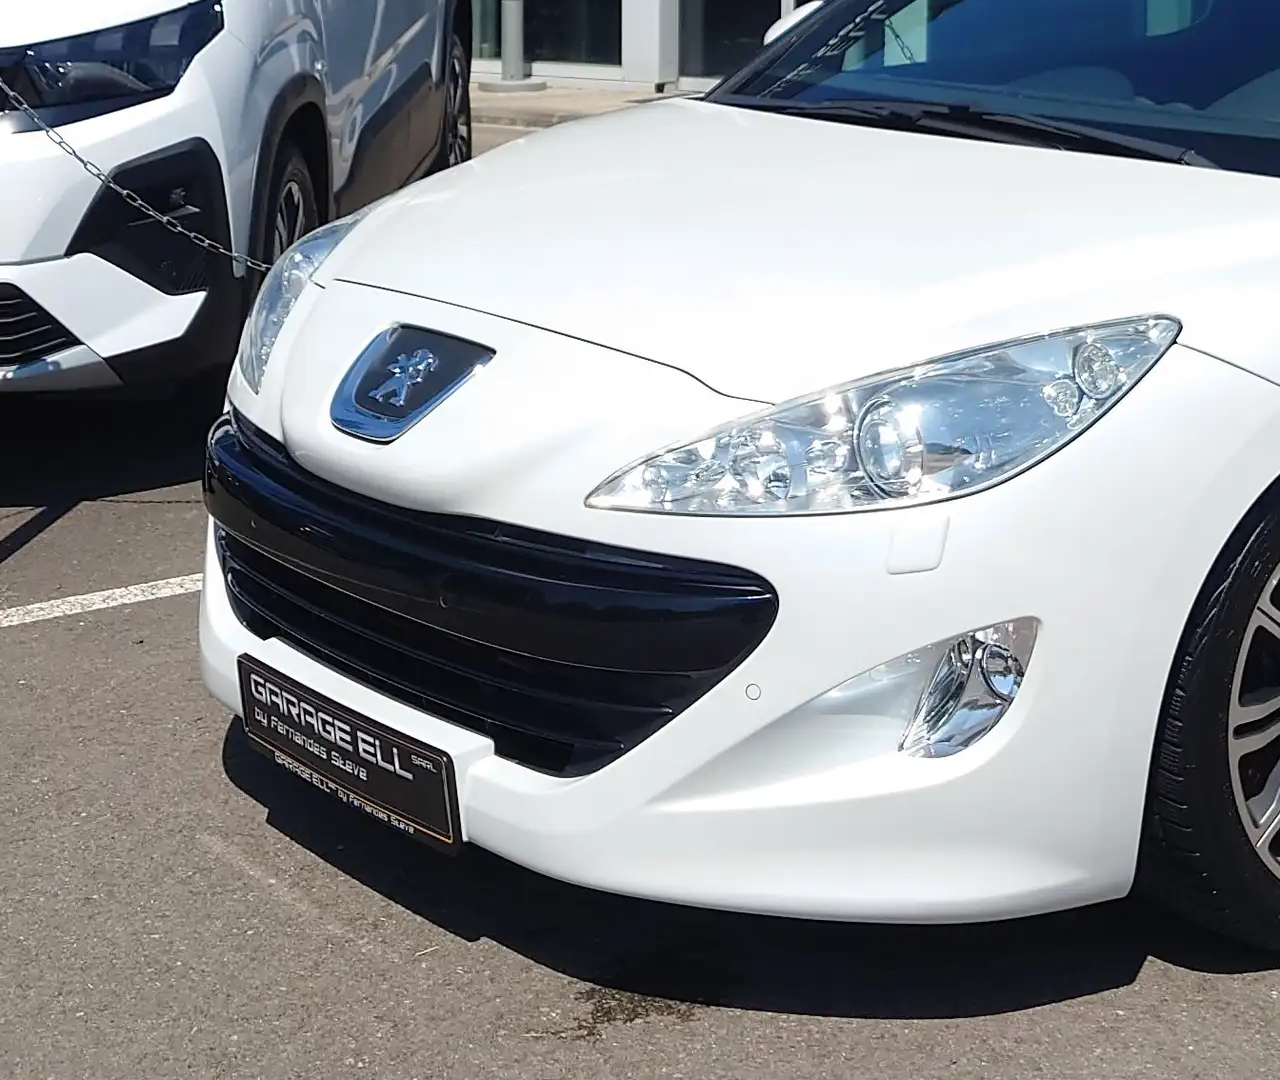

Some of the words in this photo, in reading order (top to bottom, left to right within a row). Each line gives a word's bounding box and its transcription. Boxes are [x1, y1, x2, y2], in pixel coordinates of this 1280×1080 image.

[250, 673, 353, 752] GARAGE
[357, 731, 413, 781] ELL
[411, 754, 437, 773] SARL
[254, 707, 268, 728] by
[271, 715, 328, 760] Fernandes
[330, 750, 368, 781] Steve
[274, 751, 312, 782] GARAGE
[312, 774, 331, 793] ELL
[338, 789, 348, 803] by
[349, 795, 388, 821] Fernandes
[390, 816, 415, 834] Steve
